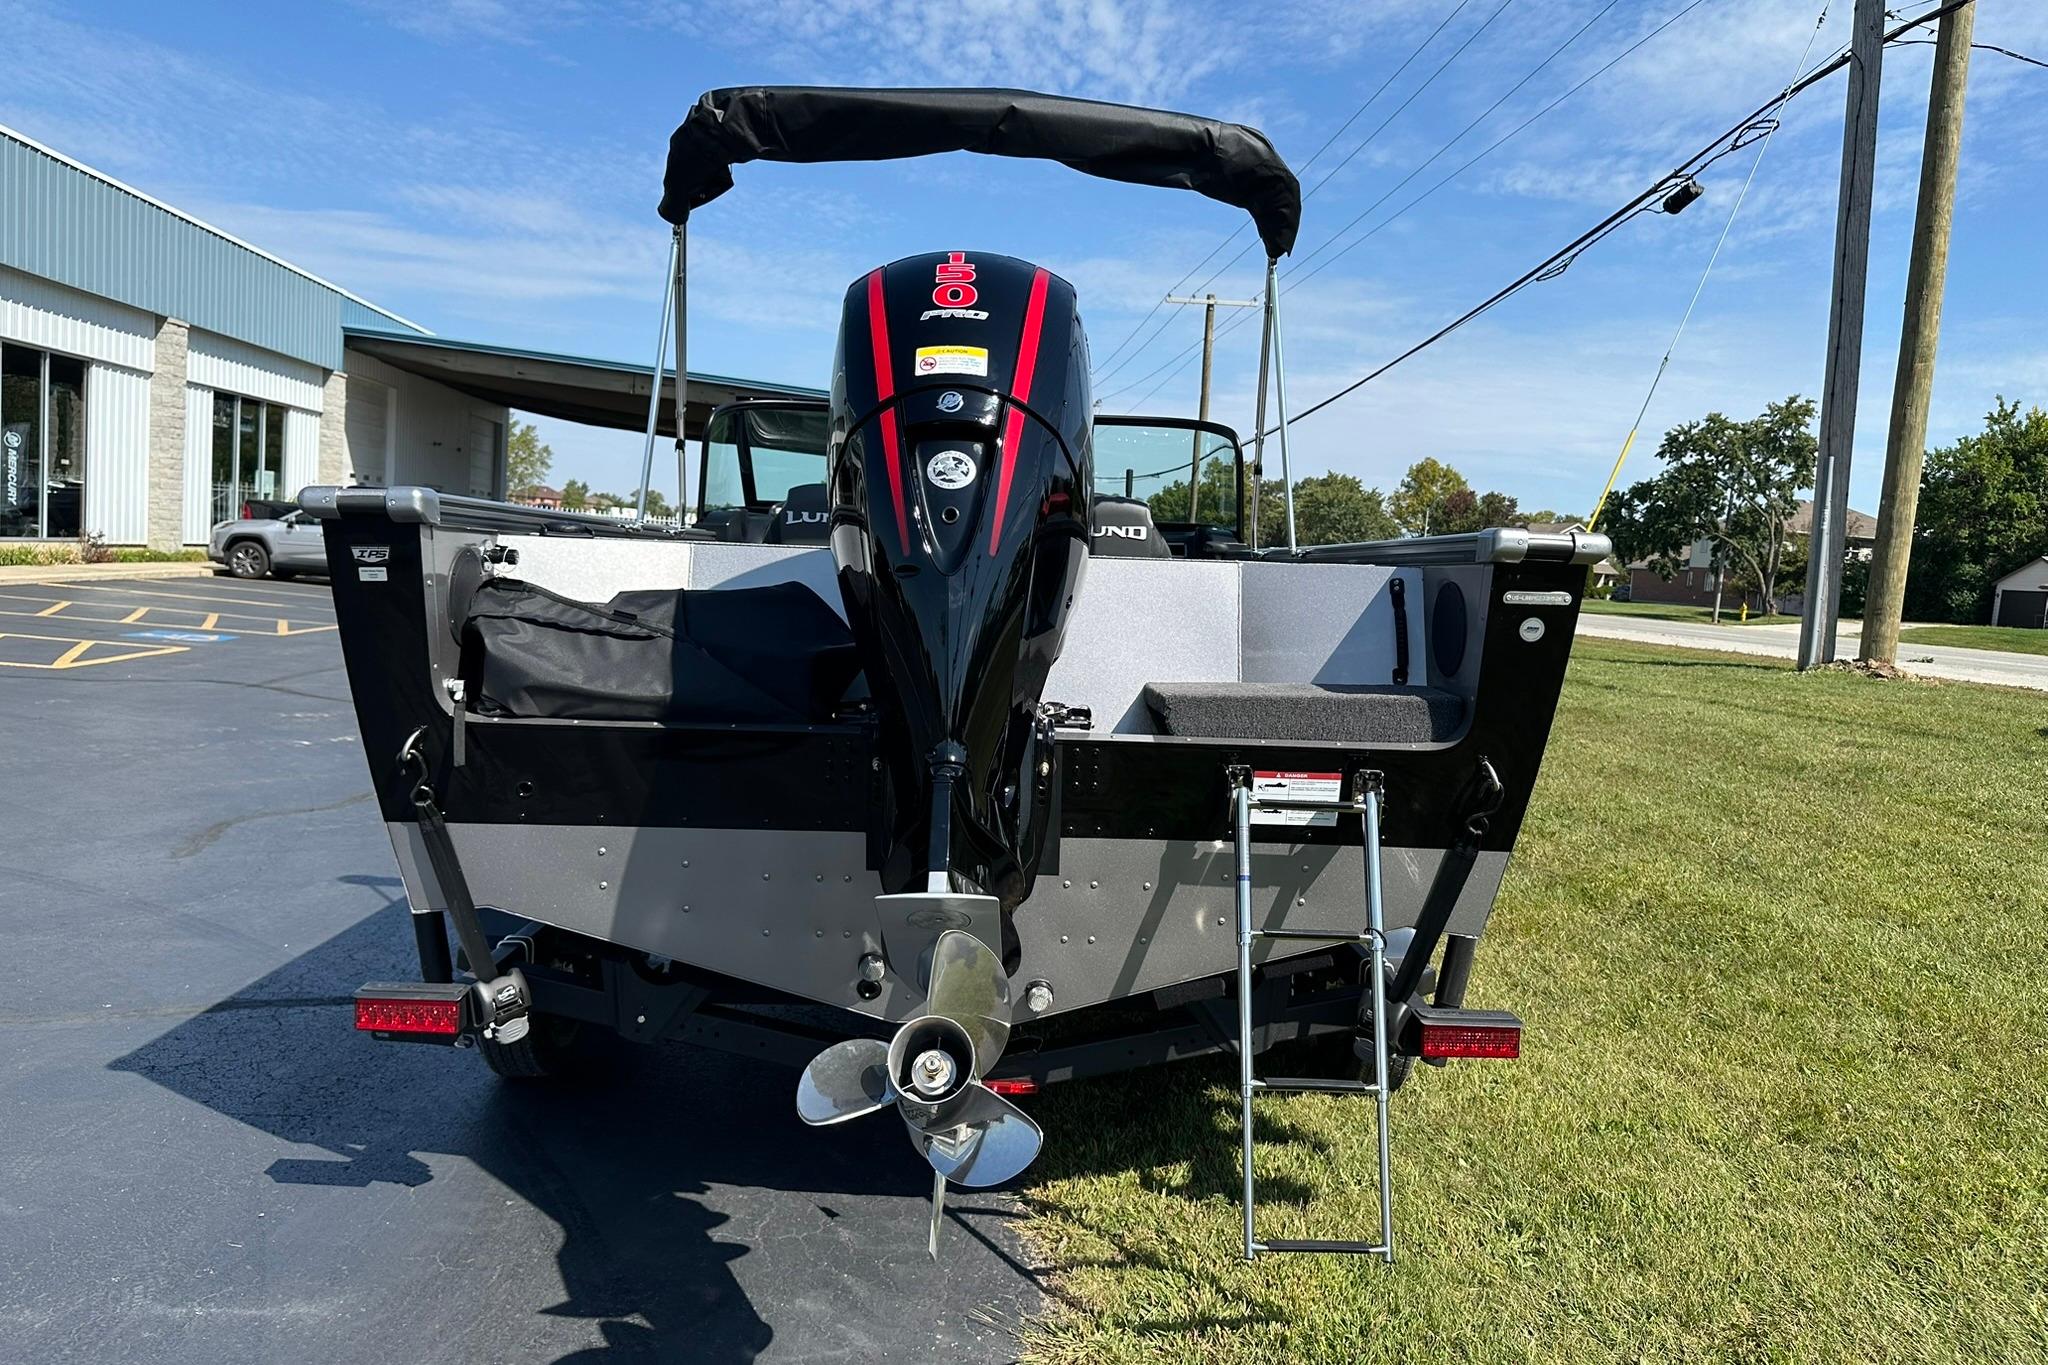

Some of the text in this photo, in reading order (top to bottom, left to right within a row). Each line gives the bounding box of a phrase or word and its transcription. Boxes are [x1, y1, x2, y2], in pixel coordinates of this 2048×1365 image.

[932, 252, 978, 308] 150
[920, 309, 989, 321] PRO
[7, 448, 17, 506] MERCURY
[785, 510, 829, 525] LU
[1091, 525, 1147, 540] UND
